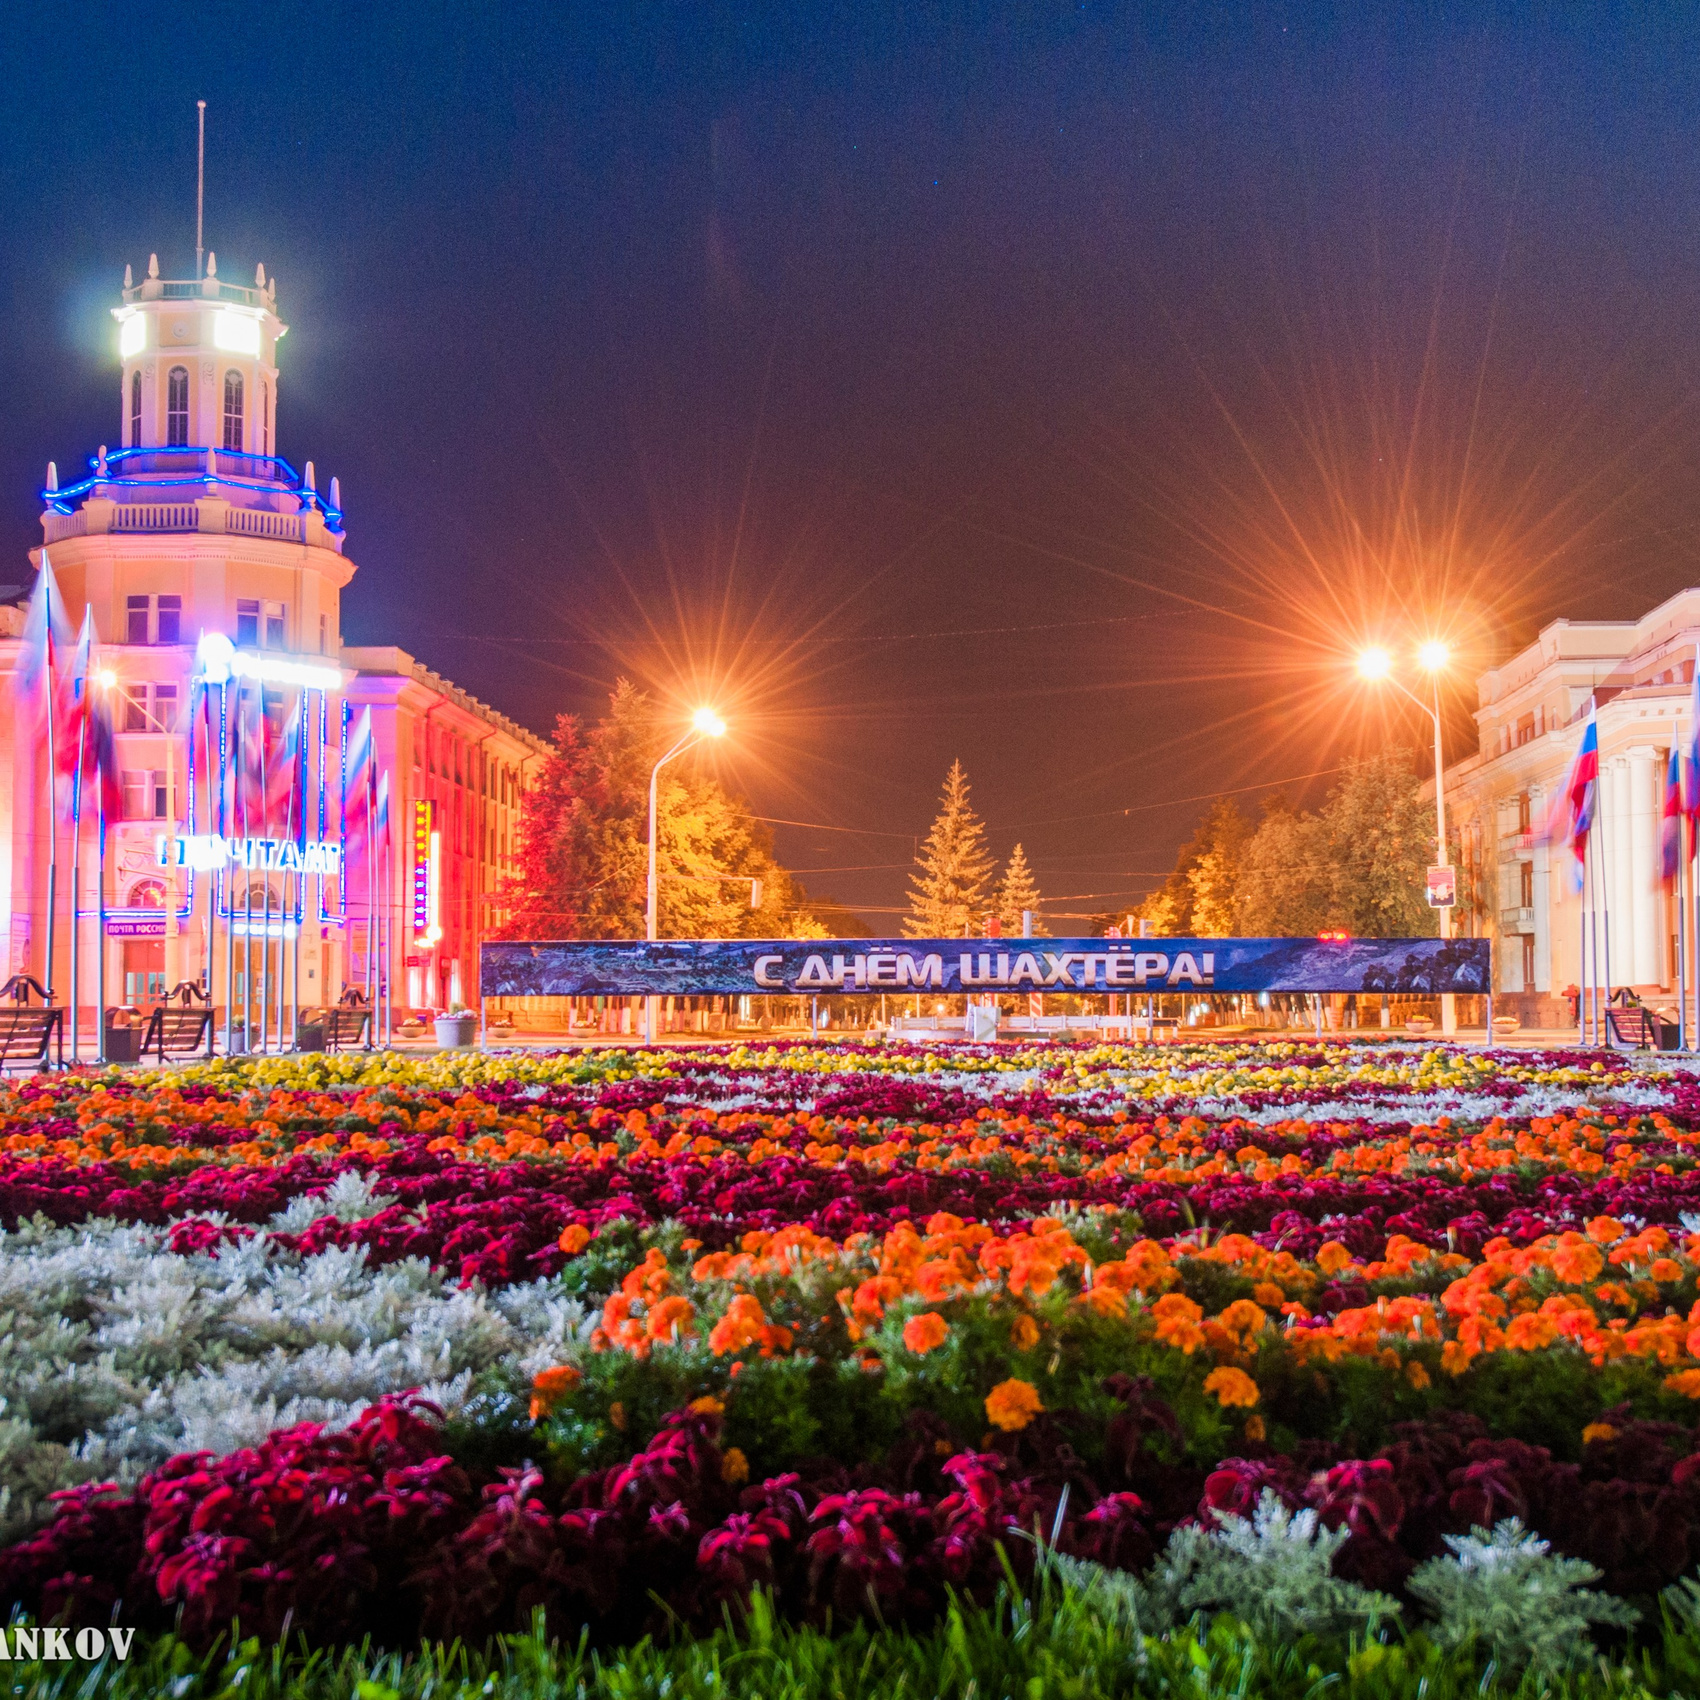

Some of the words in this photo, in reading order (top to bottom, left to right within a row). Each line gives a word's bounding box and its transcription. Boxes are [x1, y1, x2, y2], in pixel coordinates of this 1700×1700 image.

[157, 834, 342, 874] ПЧТАМТ
[108, 925, 134, 933] ПОЧТА
[753, 955, 783, 986] С
[795, 946, 943, 986] ДНЁМ
[959, 945, 1215, 986] ШАХТЁРА!
